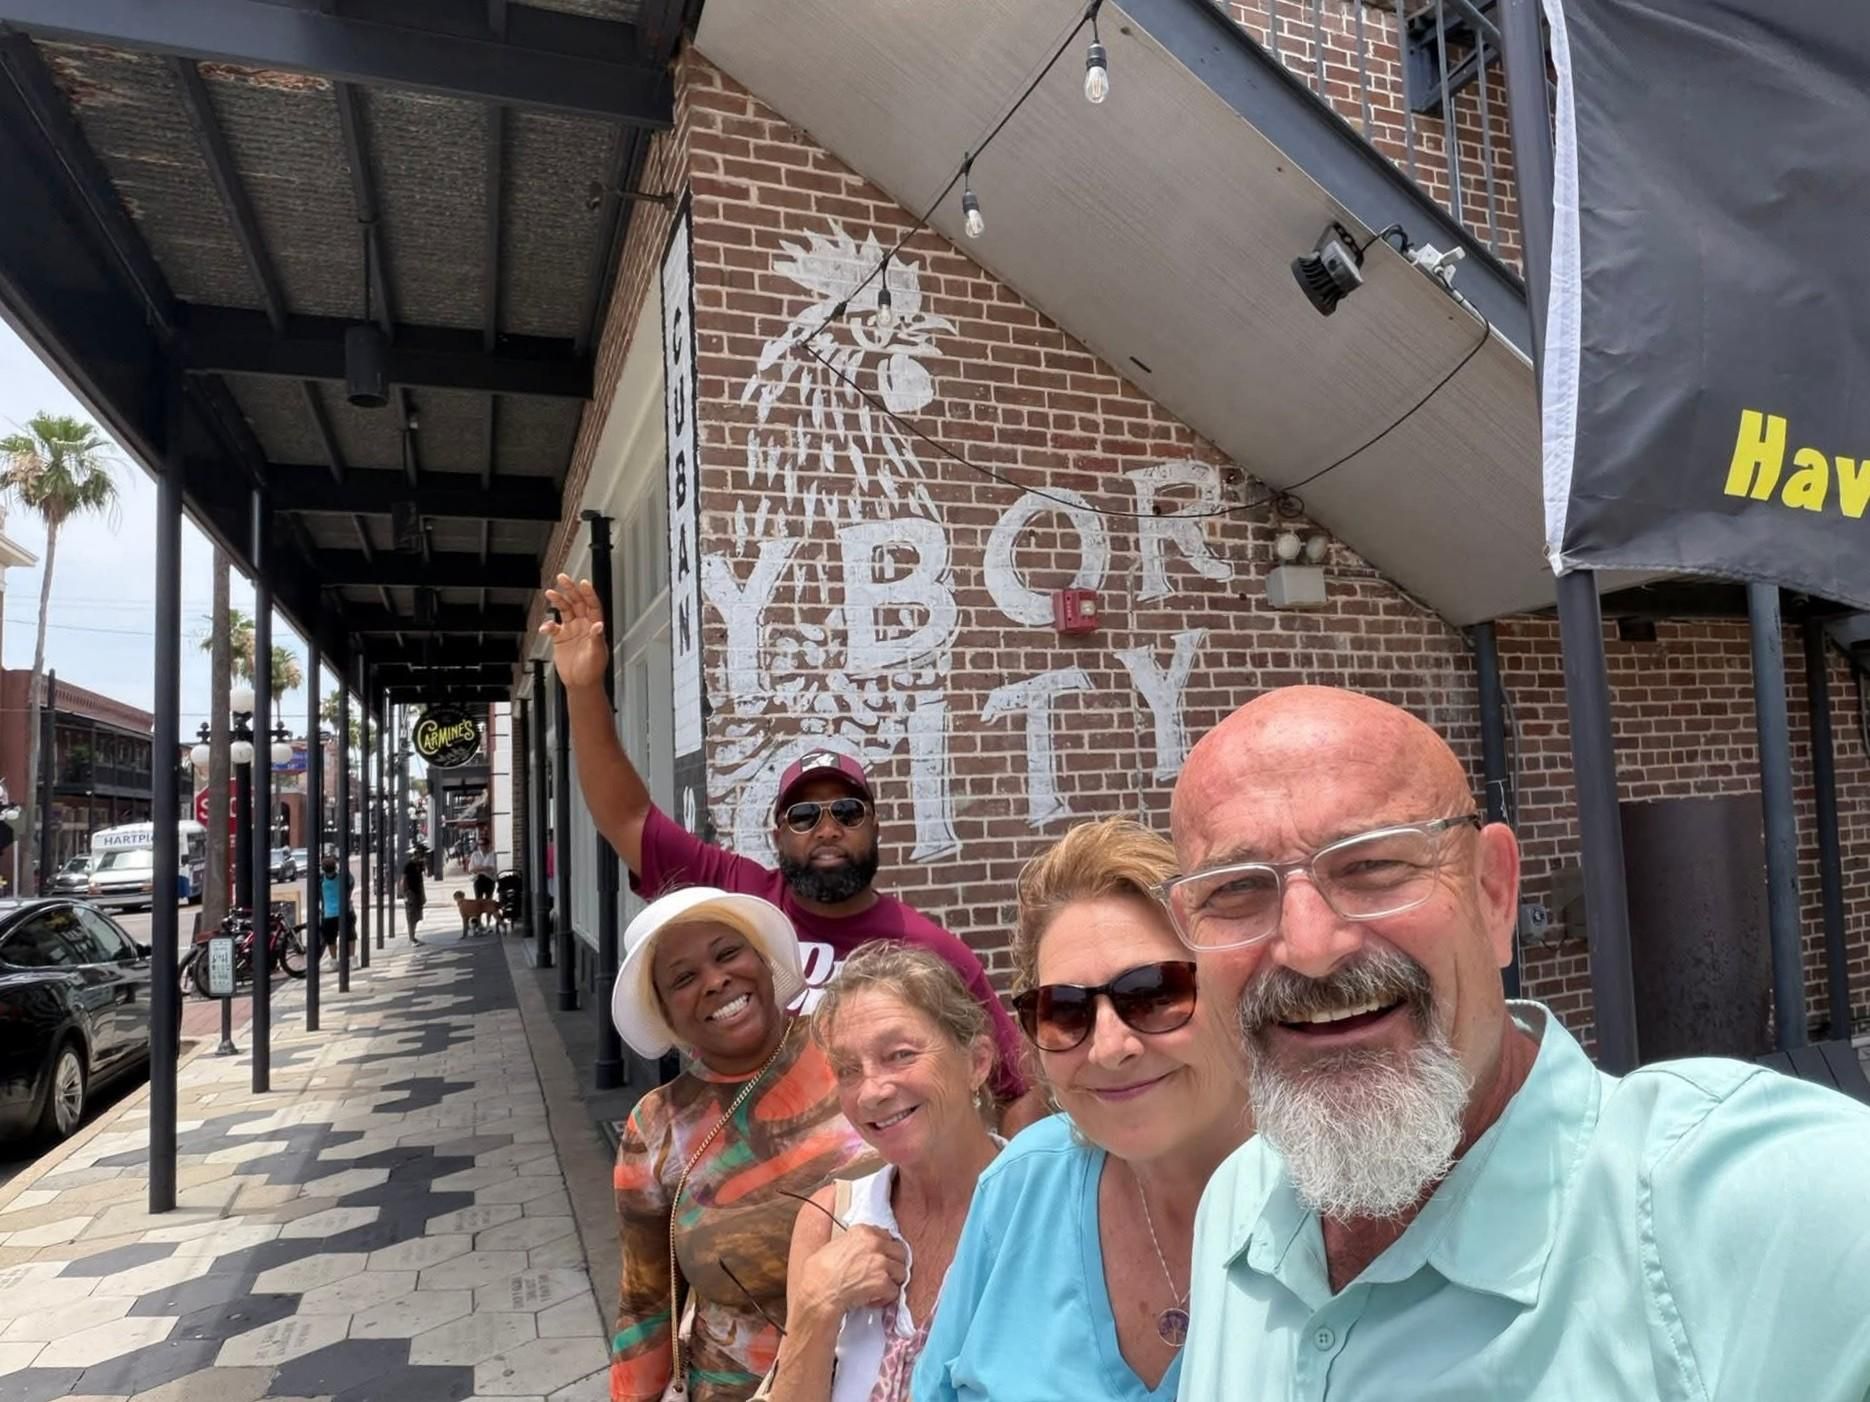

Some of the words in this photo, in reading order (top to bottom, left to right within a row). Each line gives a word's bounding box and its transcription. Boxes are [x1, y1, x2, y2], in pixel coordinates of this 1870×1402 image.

[673, 306, 691, 657] CUBAN
[700, 458, 1234, 712] YBOR
[1724, 409, 1870, 518] Hav
